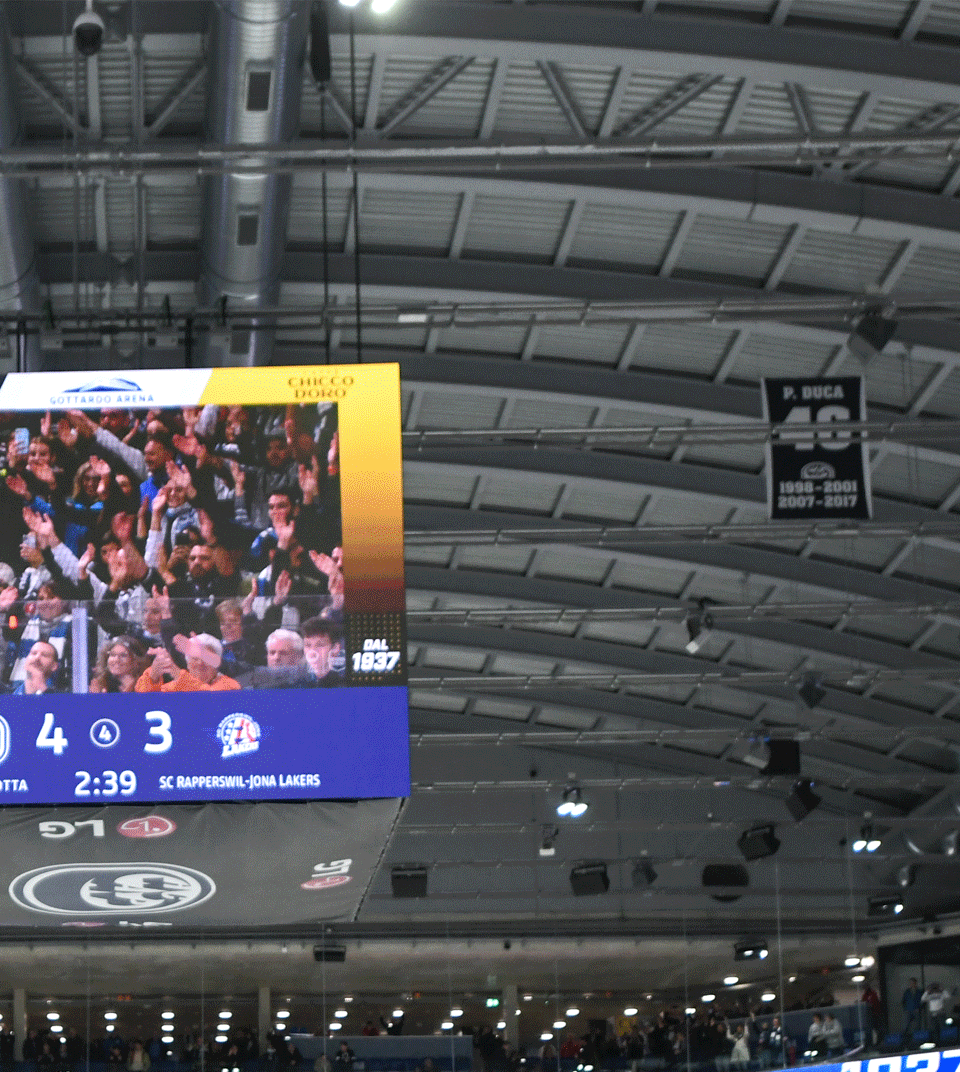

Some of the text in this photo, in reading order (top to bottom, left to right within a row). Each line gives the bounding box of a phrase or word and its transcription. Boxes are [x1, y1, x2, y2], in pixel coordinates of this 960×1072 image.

[288, 376, 354, 387] CHICCO
[49, 394, 154, 404] GOTTARDO ARENA
[783, 384, 844, 400] P. DUCA
[362, 638, 389, 651] DAL
[351, 651, 400, 672] 1937
[36, 712, 68, 755] 4
[98, 724, 111, 742] 4
[144, 710, 172, 753] 3
[74, 770, 137, 796] 2:39
[159, 773, 321, 790] SC RAPPERSWIL-JONA LAKERS
[39, 819, 105, 838] LG
